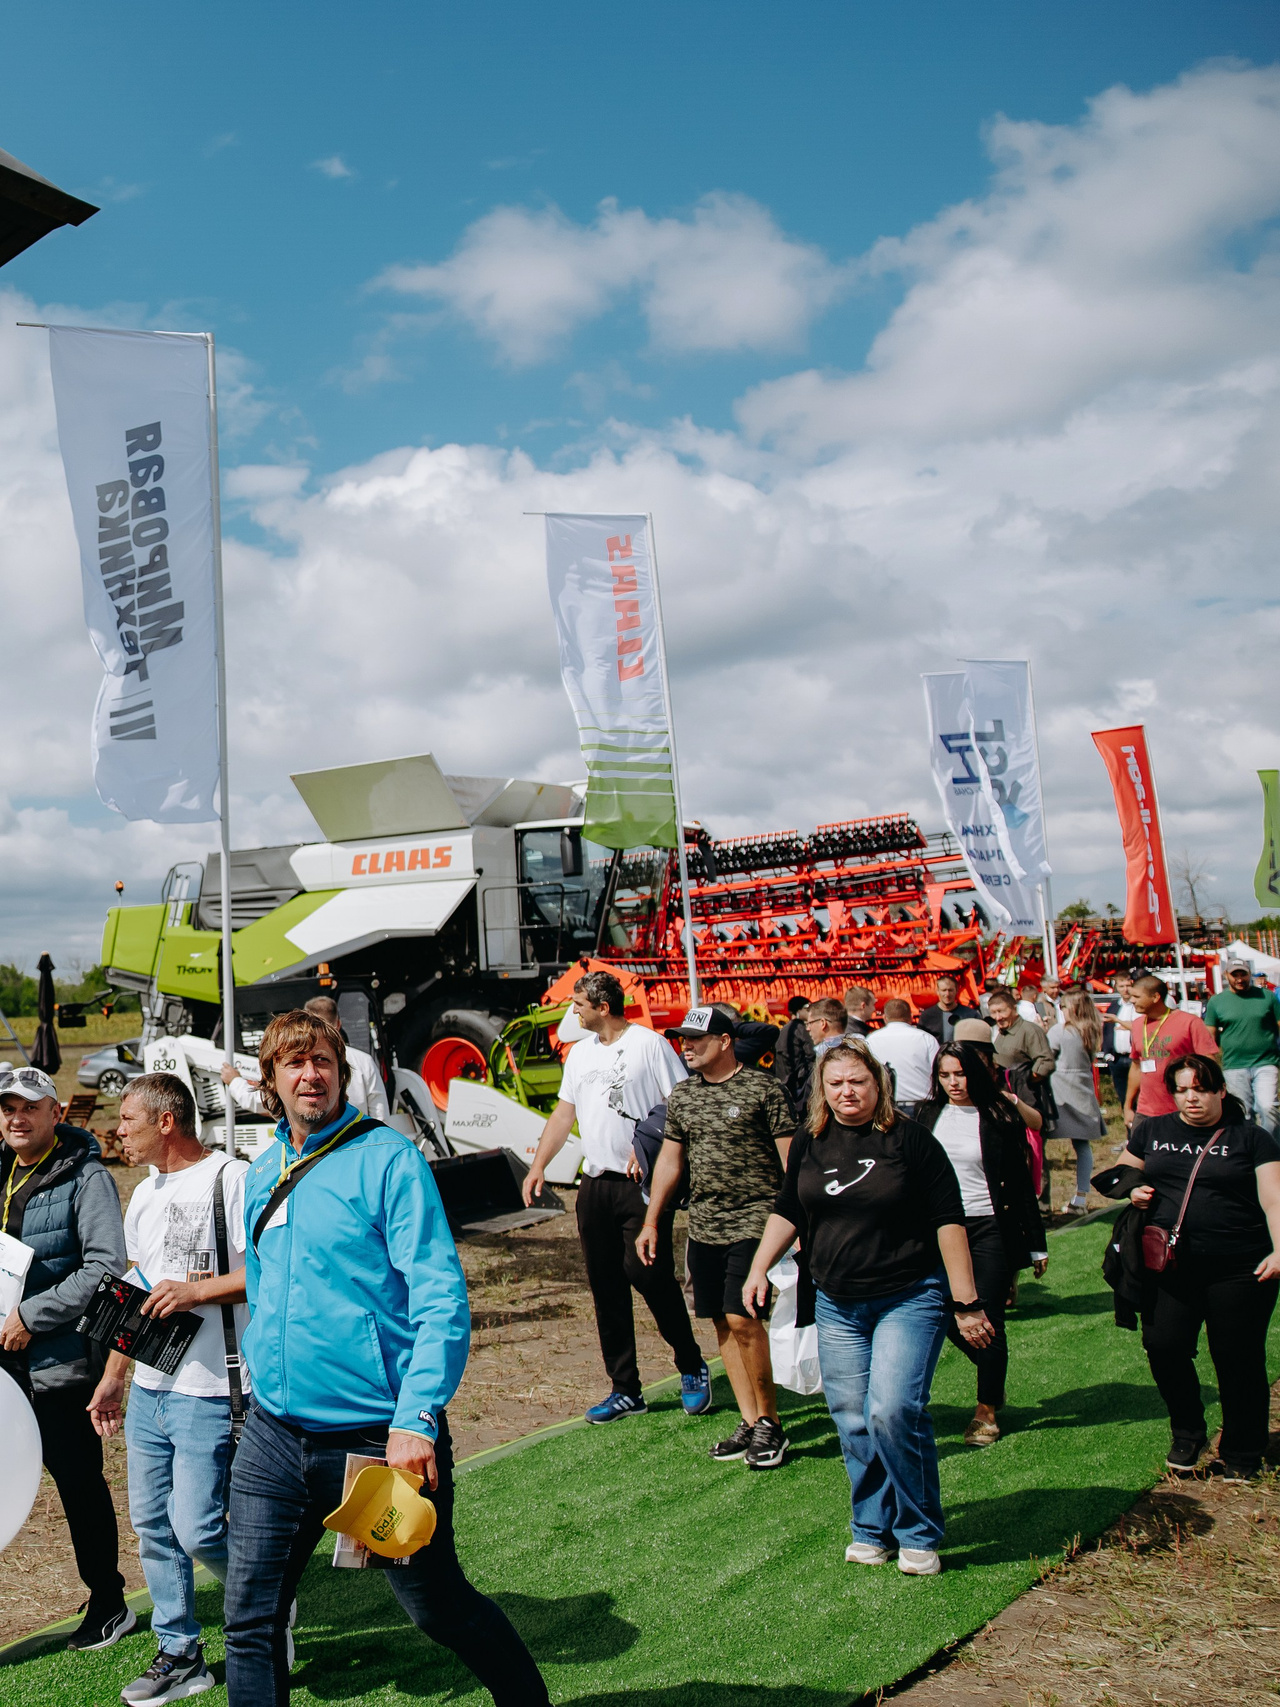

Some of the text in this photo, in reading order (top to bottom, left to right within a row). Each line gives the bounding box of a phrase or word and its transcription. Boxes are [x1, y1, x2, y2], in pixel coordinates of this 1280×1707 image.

[351, 845, 452, 876] CLAAS
[153, 1058, 176, 1071] 830
[452, 1120, 493, 1128] MAXFLEX
[473, 1113, 498, 1123] 930
[1152, 1140, 1229, 1157] BALANCE
[193, 1252, 210, 1271] 19
